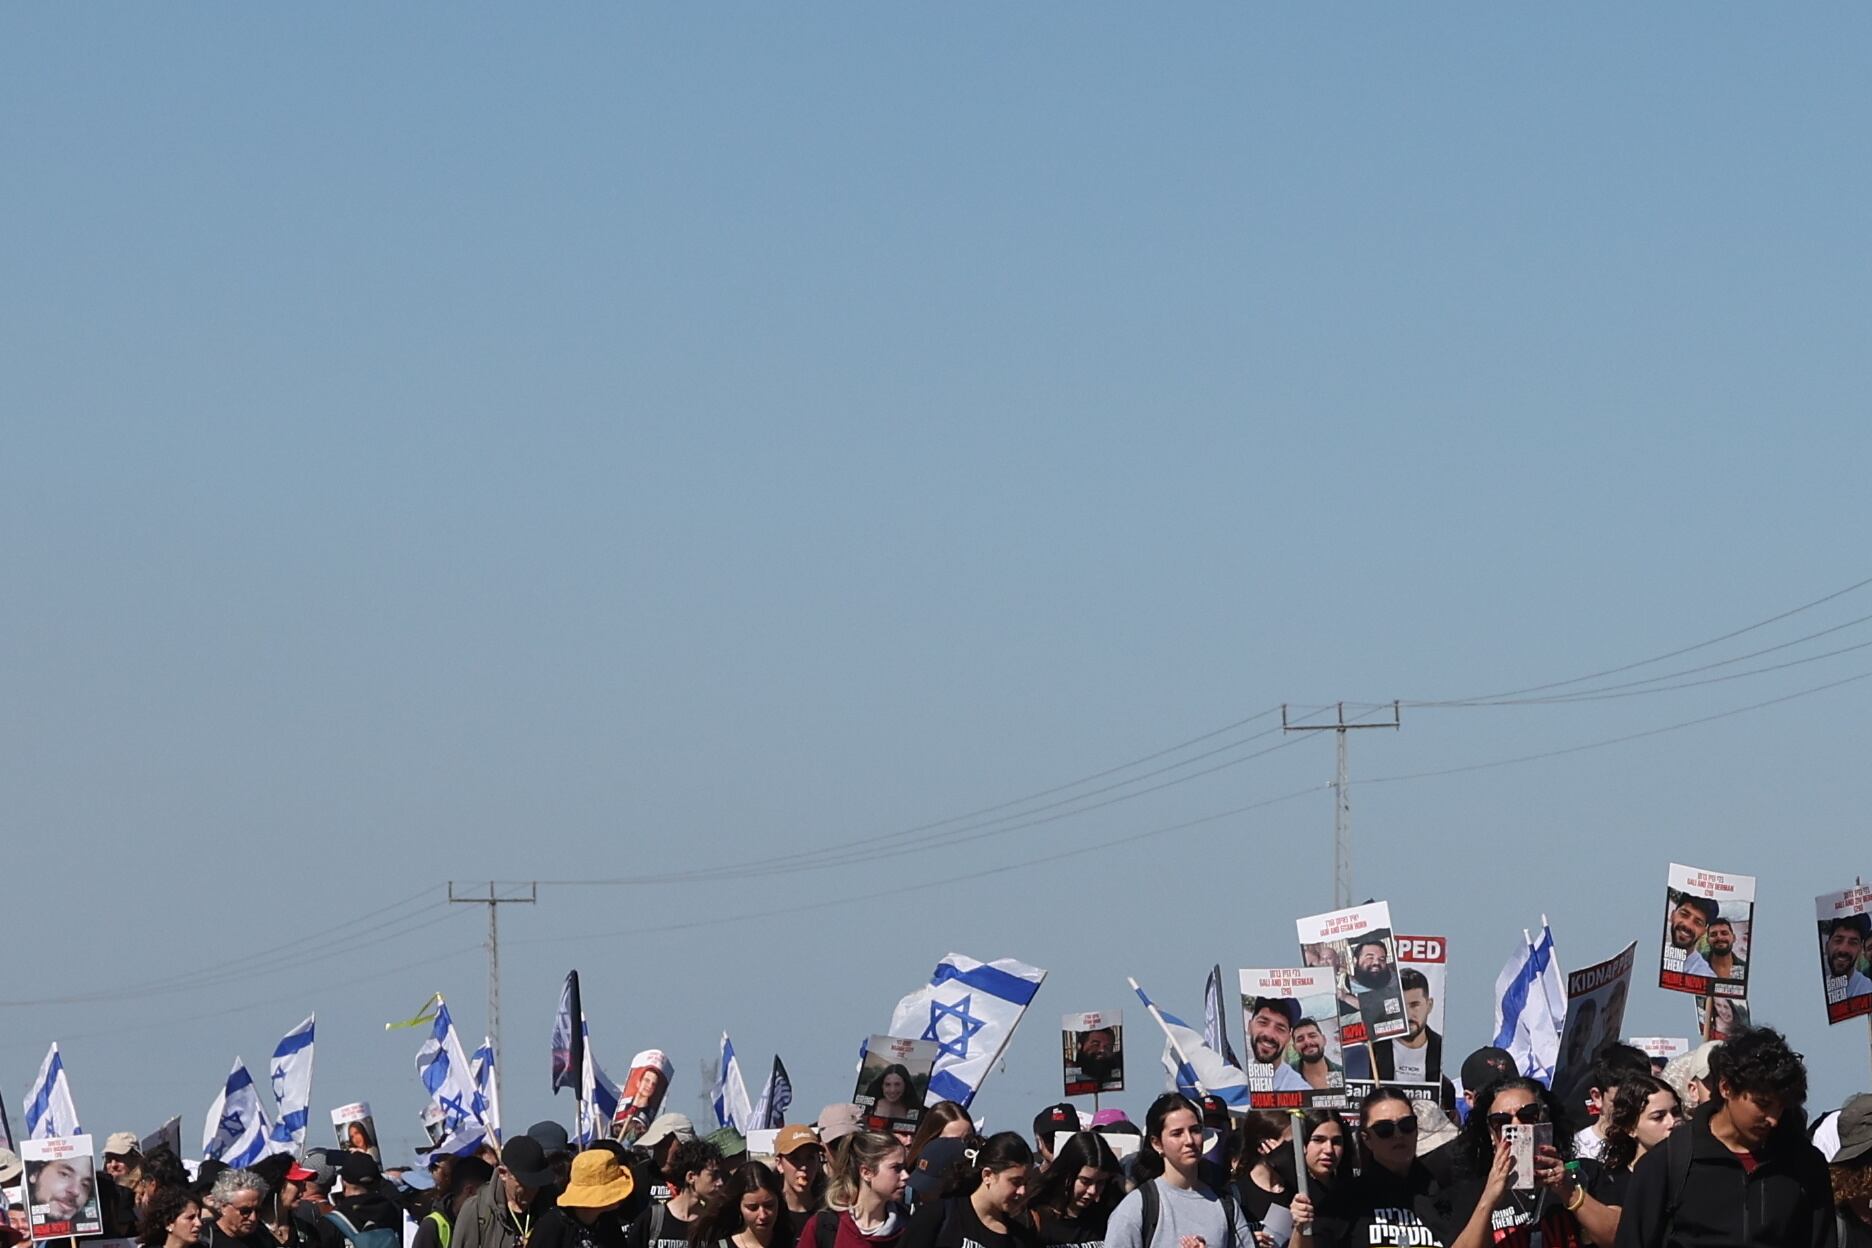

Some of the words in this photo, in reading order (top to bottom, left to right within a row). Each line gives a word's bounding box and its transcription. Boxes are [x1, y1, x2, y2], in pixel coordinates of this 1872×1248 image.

[1664, 946, 1687, 960] BRING
[1663, 957, 1684, 972] THEM
[1826, 975, 1848, 990] BRING
[1828, 988, 1848, 1004] THEM
[1249, 1063, 1274, 1077] BRING
[1250, 1078, 1273, 1092] THEM
[1345, 1085, 1371, 1098] Gali
[1492, 1216, 1514, 1231] THEM
